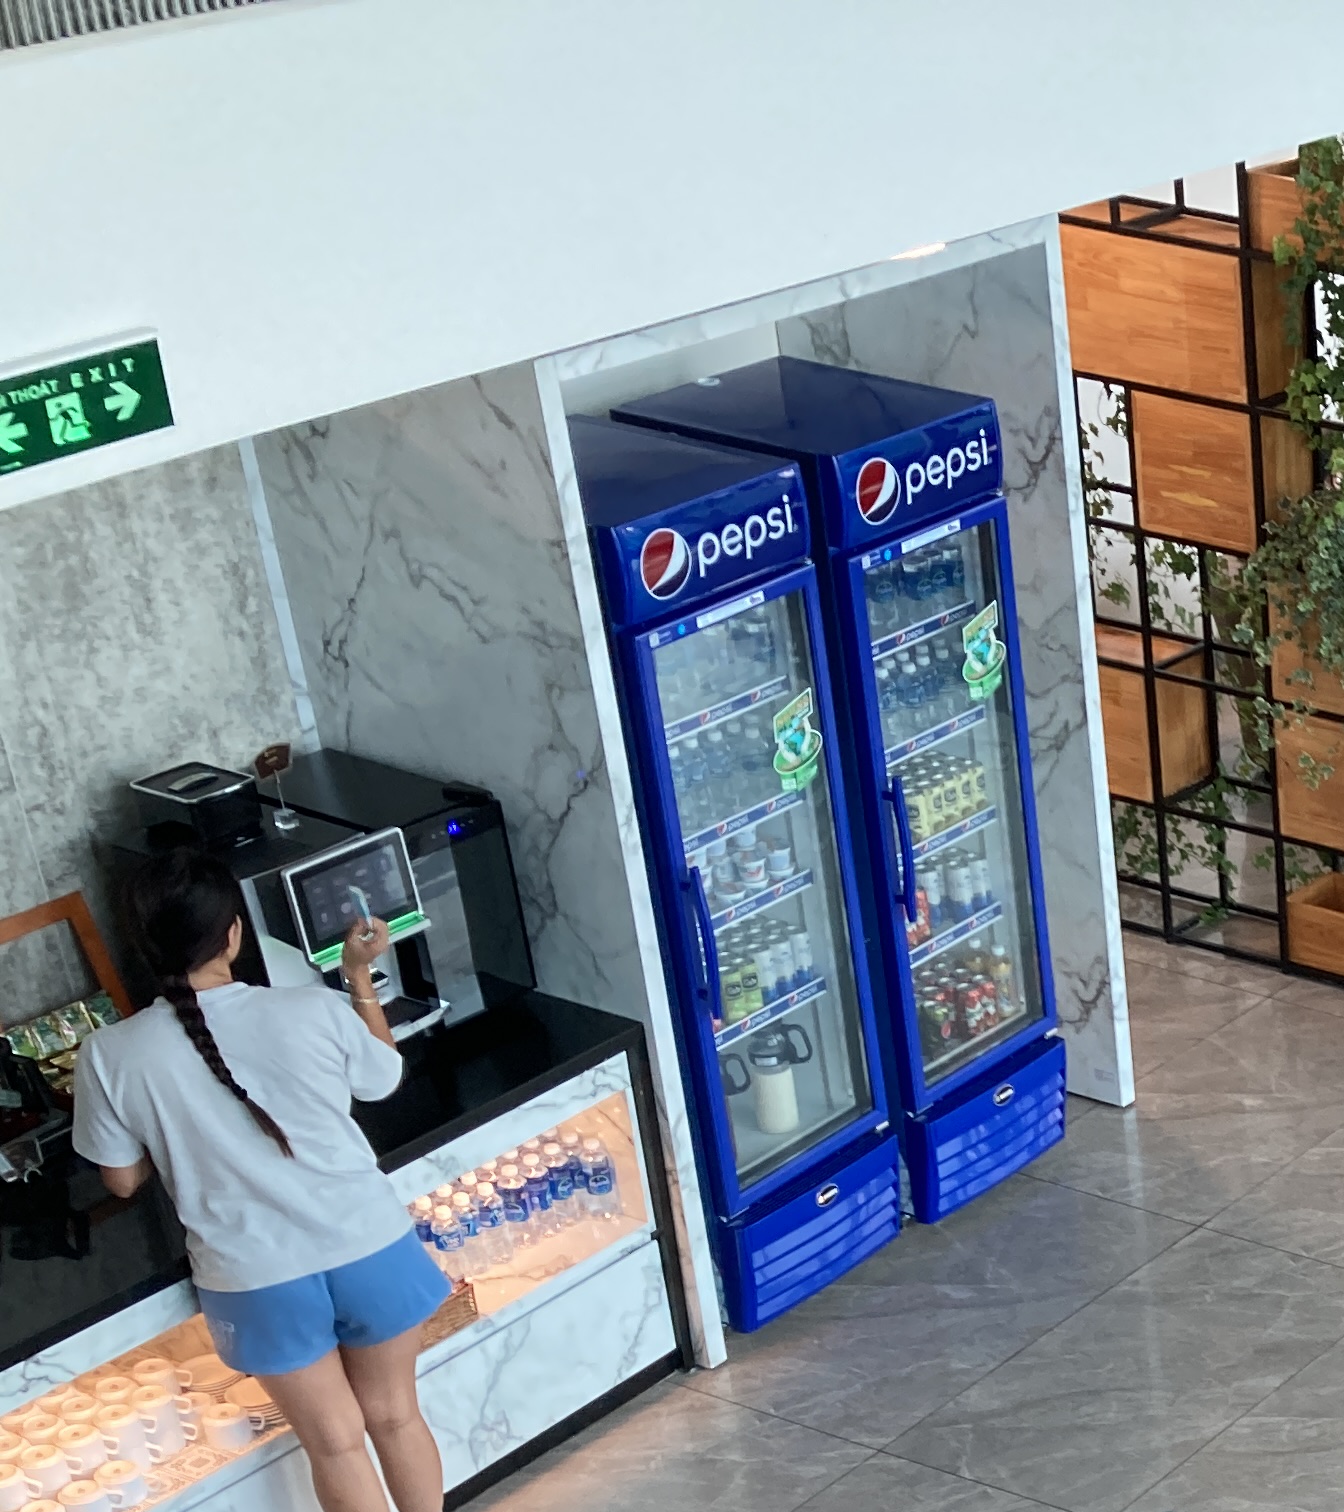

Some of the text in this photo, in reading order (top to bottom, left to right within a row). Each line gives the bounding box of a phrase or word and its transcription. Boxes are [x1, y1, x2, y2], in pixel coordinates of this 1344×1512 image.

[8, 380, 59, 405] THOÁT
[70, 357, 134, 389] EXIT
[904, 428, 989, 506] pepsi
[697, 494, 794, 578] pepsi
